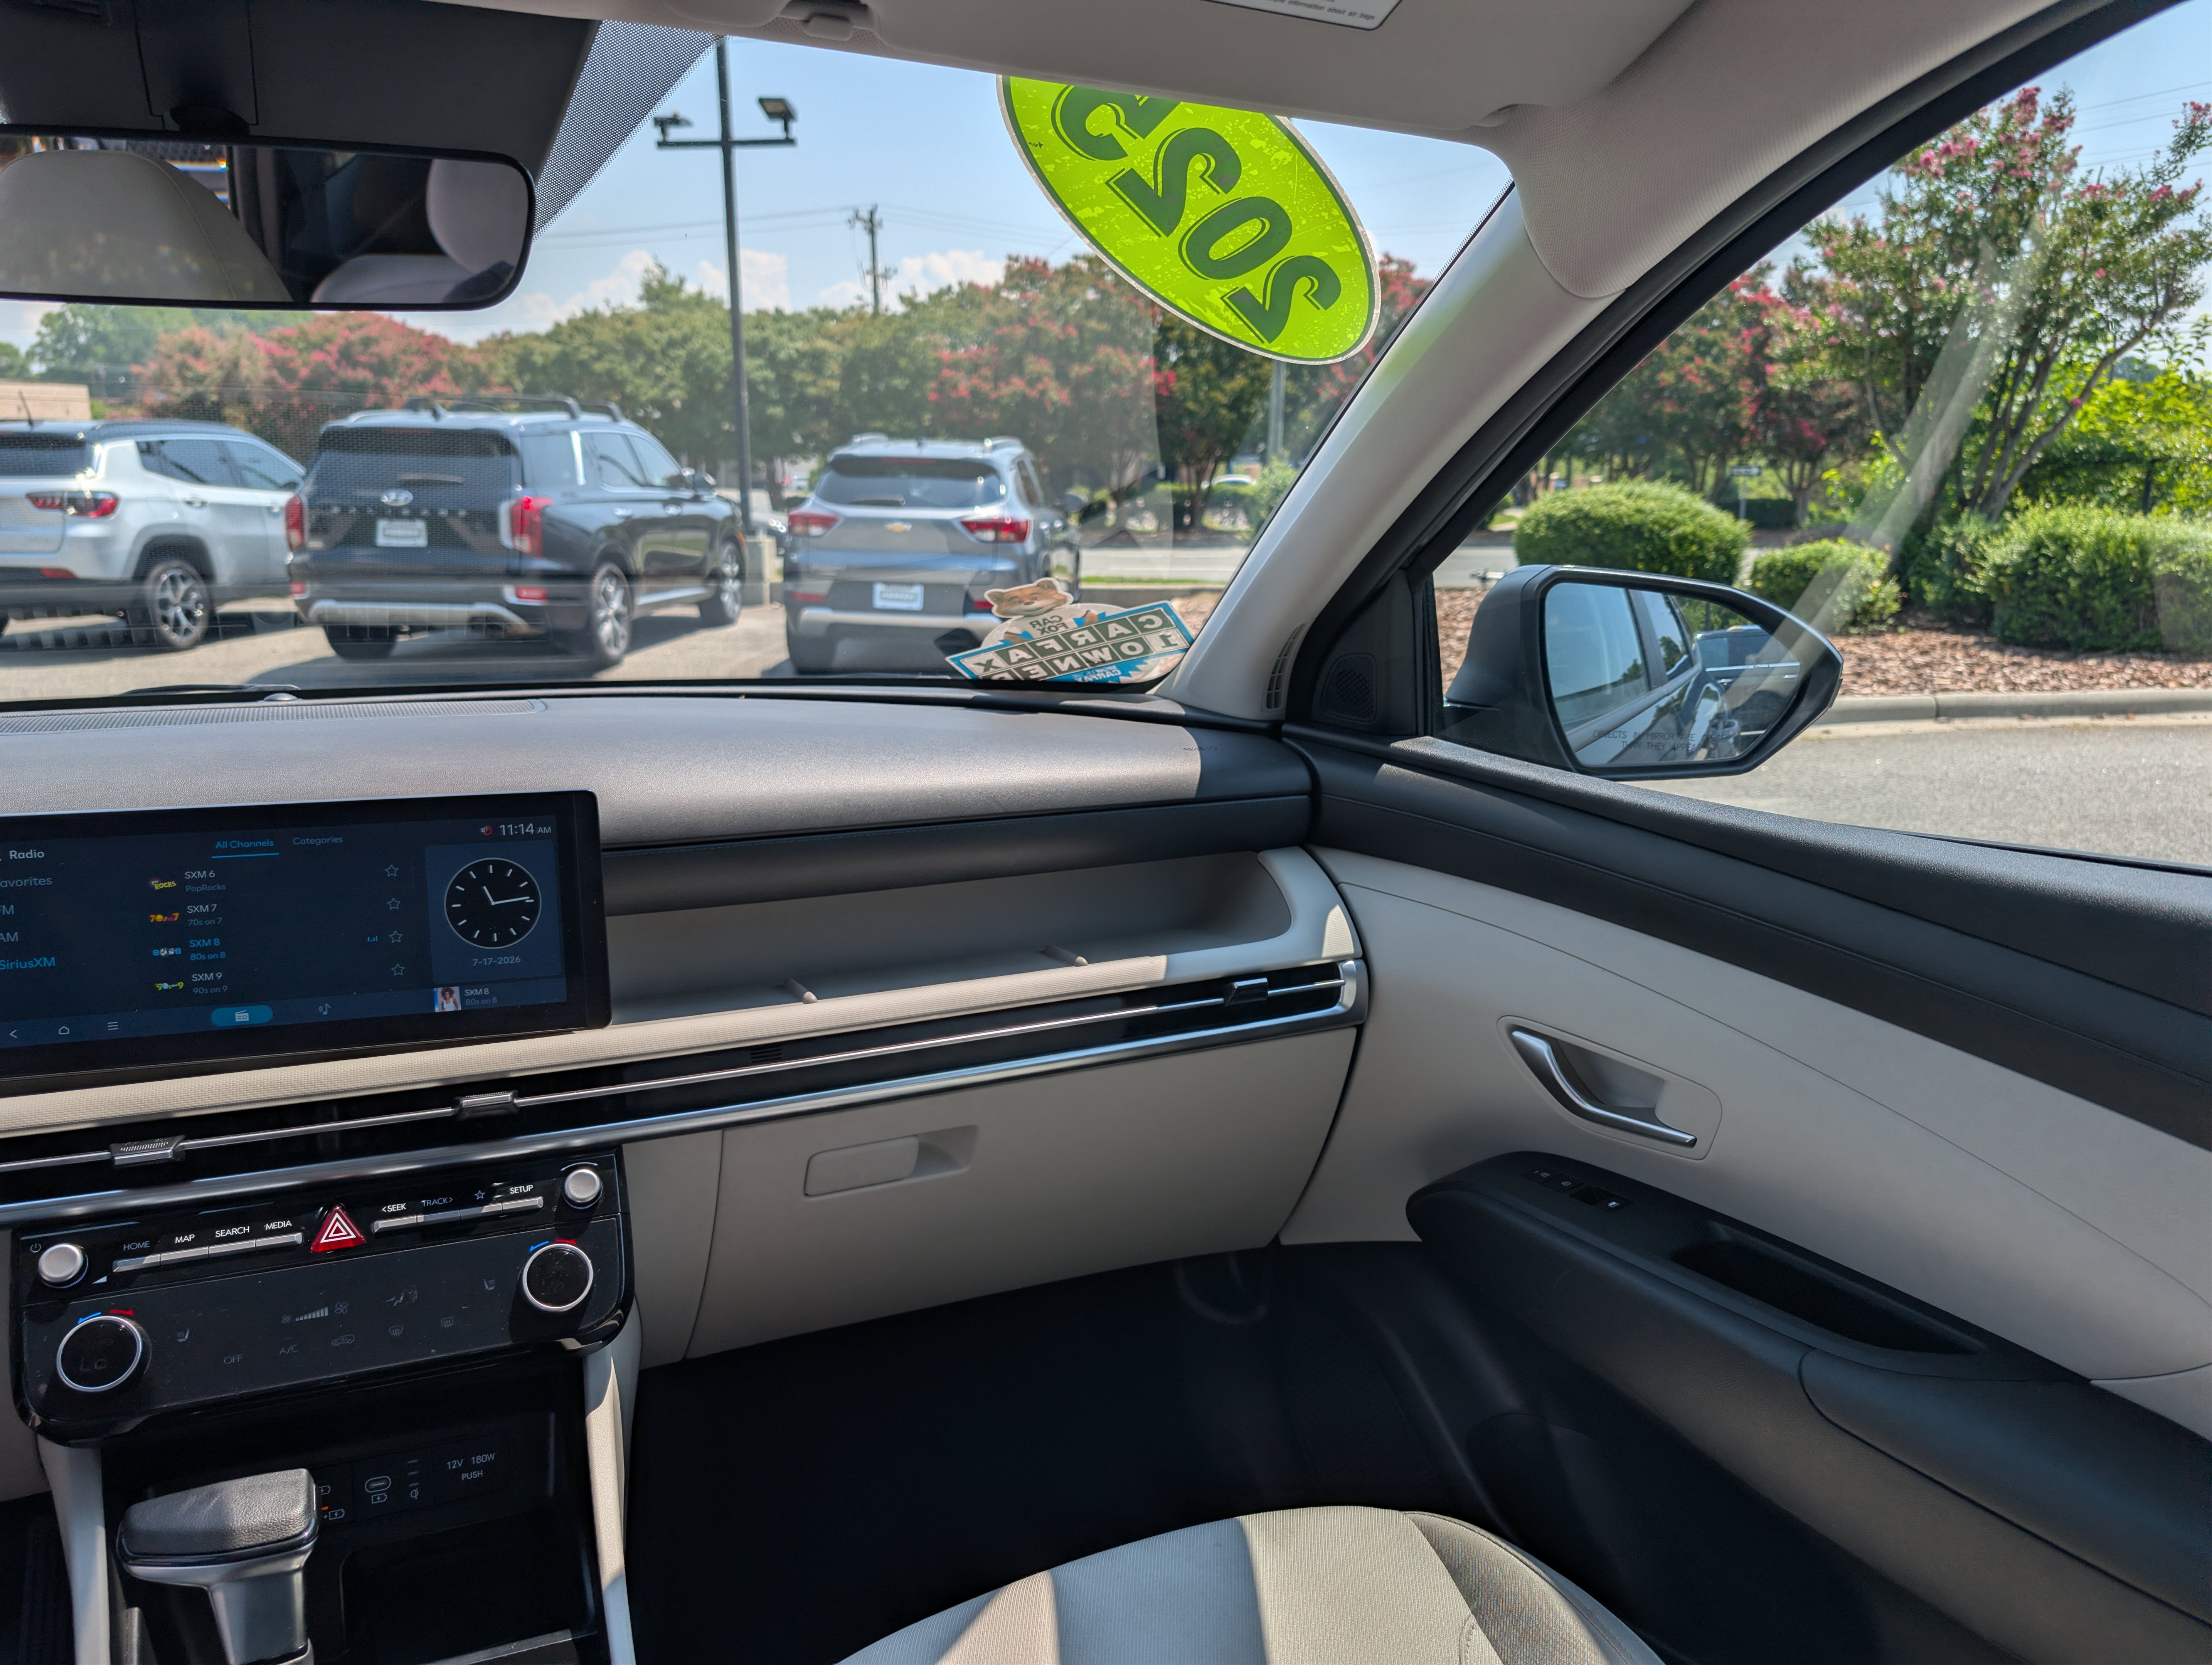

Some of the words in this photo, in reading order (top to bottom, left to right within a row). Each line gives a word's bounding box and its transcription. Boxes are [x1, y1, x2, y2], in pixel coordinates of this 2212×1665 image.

[1645, 733, 1674, 741] MIRROR
[1680, 733, 1695, 742] ARE
[1646, 742, 1667, 750] THEY
[500, 823, 535, 836] 11:14
[215, 841, 227, 849] All
[229, 839, 274, 848] Channels
[293, 836, 343, 846] Categories
[9, 849, 45, 859] Radio
[184, 871, 206, 879] SXM
[0, 876, 52, 888] avorites
[185, 883, 227, 893] PopRocks
[187, 905, 209, 913] SXM
[210, 904, 217, 912] 7
[0, 932, 19, 942] AM
[189, 939, 211, 948] SXM
[213, 938, 221, 946] 8
[0, 956, 56, 970] SiriusXM
[472, 955, 521, 967] 7-17-2026
[192, 973, 214, 982] SXM
[215, 972, 222, 980] 9
[193, 987, 209, 995] 90s
[510, 1184, 534, 1194] SETUP
[265, 1219, 293, 1231] MEDIA
[215, 1226, 250, 1238] SEARCH
[175, 1233, 195, 1244] MAP
[123, 1240, 150, 1251] HOME
[279, 1344, 299, 1356] A/C
[223, 1353, 243, 1365] OFF
[447, 1458, 464, 1470] 12V
[471, 1452, 495, 1465] 180W
[461, 1470, 483, 1481] PUSH
